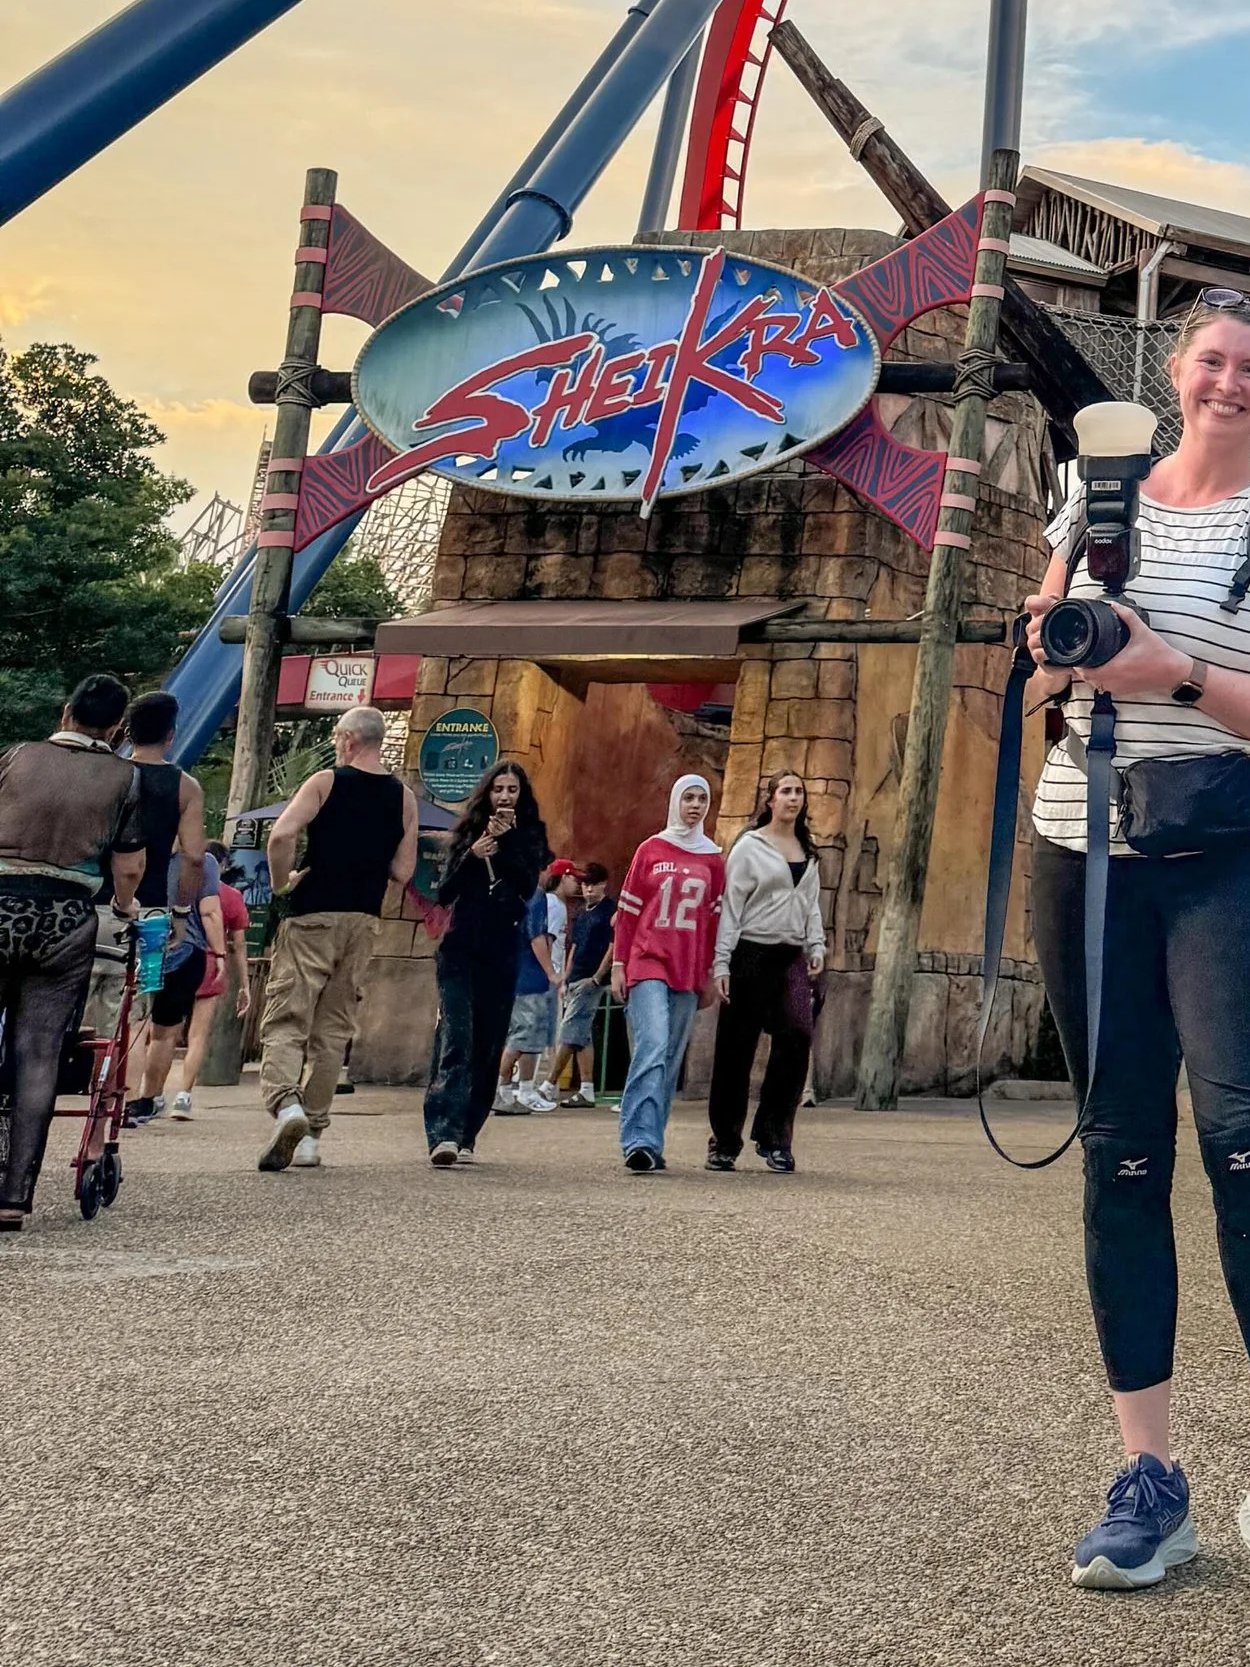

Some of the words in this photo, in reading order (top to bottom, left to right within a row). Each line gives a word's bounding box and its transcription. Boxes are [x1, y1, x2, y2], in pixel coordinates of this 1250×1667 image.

[325, 659, 368, 677] QUICK
[338, 676, 366, 687] QUEUE
[309, 690, 354, 701] Entrance
[436, 722, 489, 732] ENTRANCE
[655, 876, 707, 931] 12
